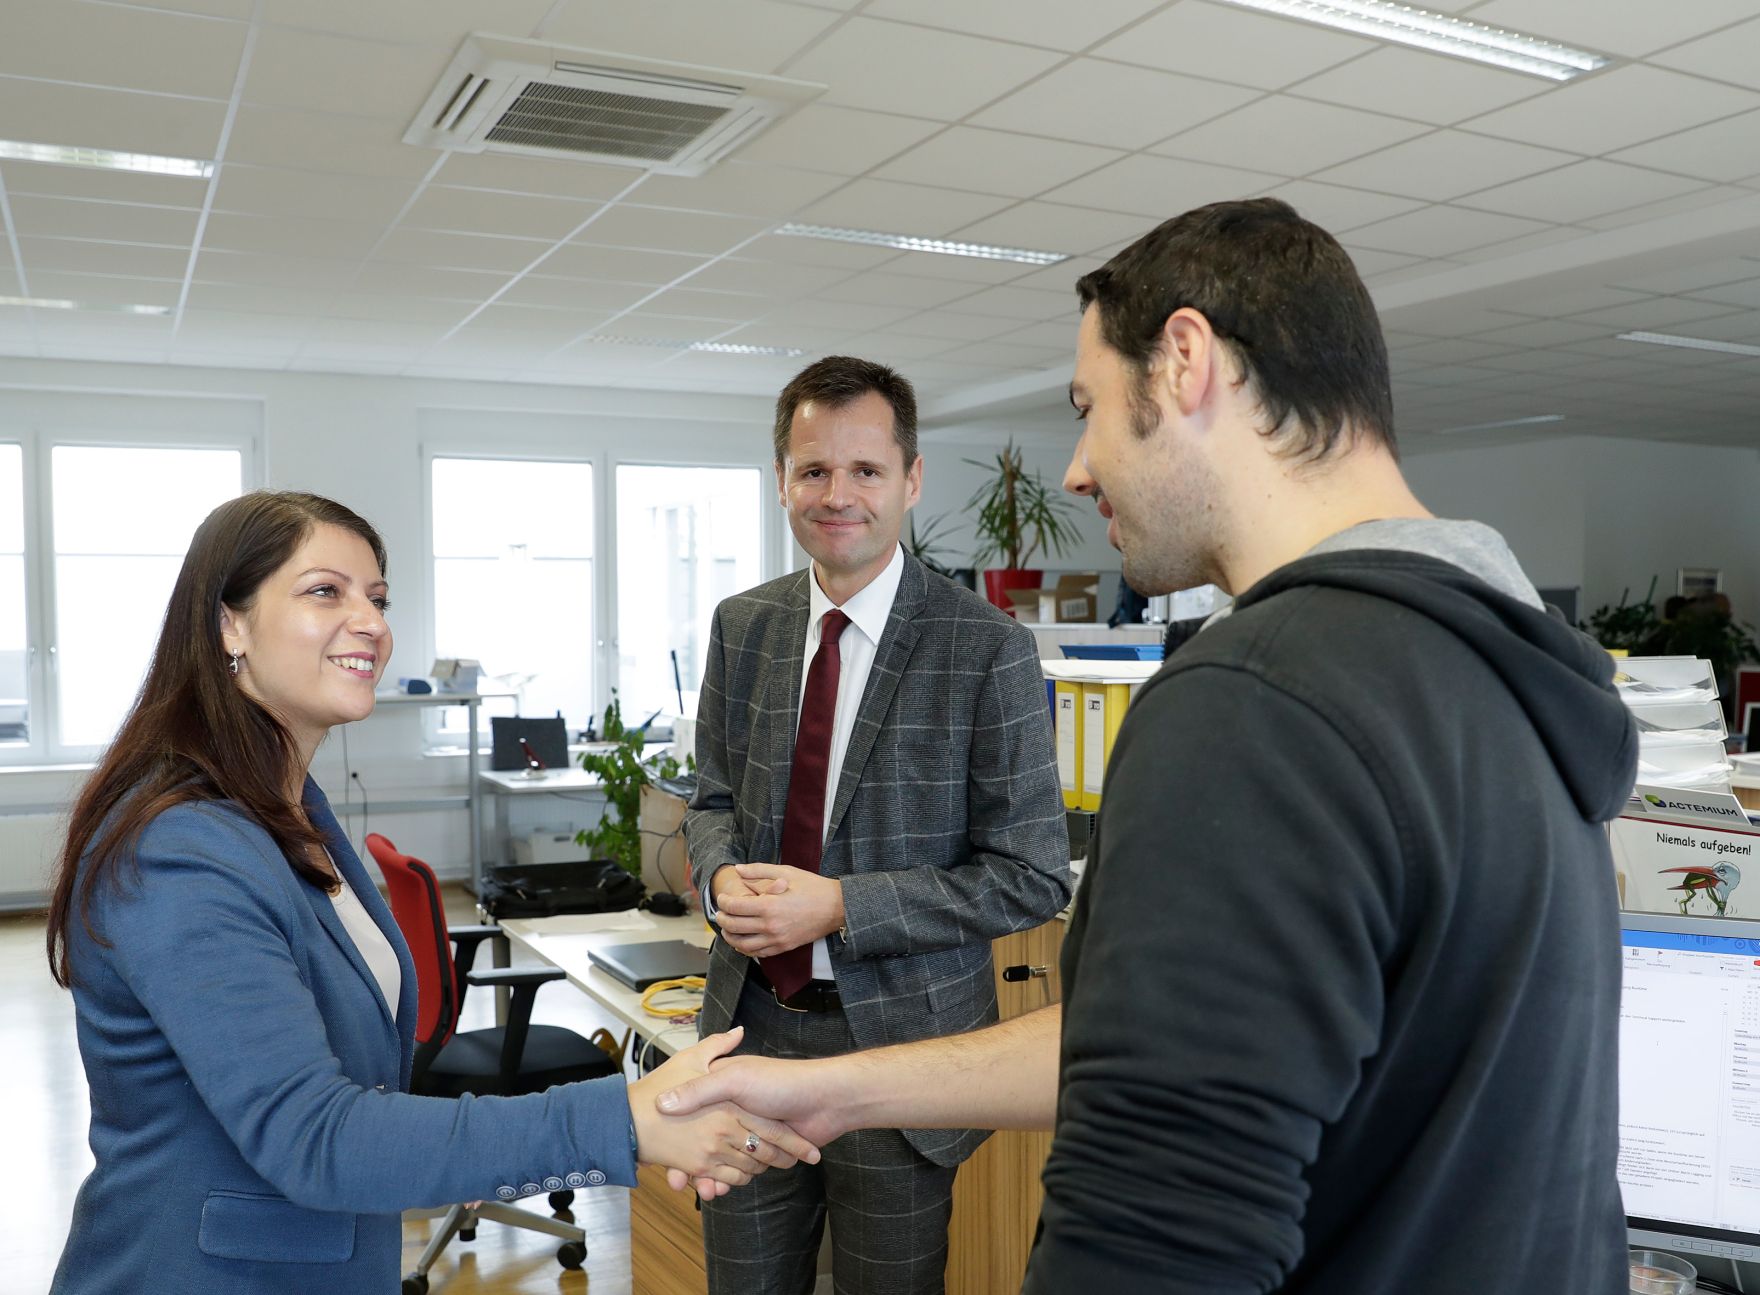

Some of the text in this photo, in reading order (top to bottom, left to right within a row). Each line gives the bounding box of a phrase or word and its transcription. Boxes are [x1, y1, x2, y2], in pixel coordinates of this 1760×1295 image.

[1669, 801, 1738, 816] ACTEMIUM
[1656, 832, 1751, 856] Niemals aufgeben!
